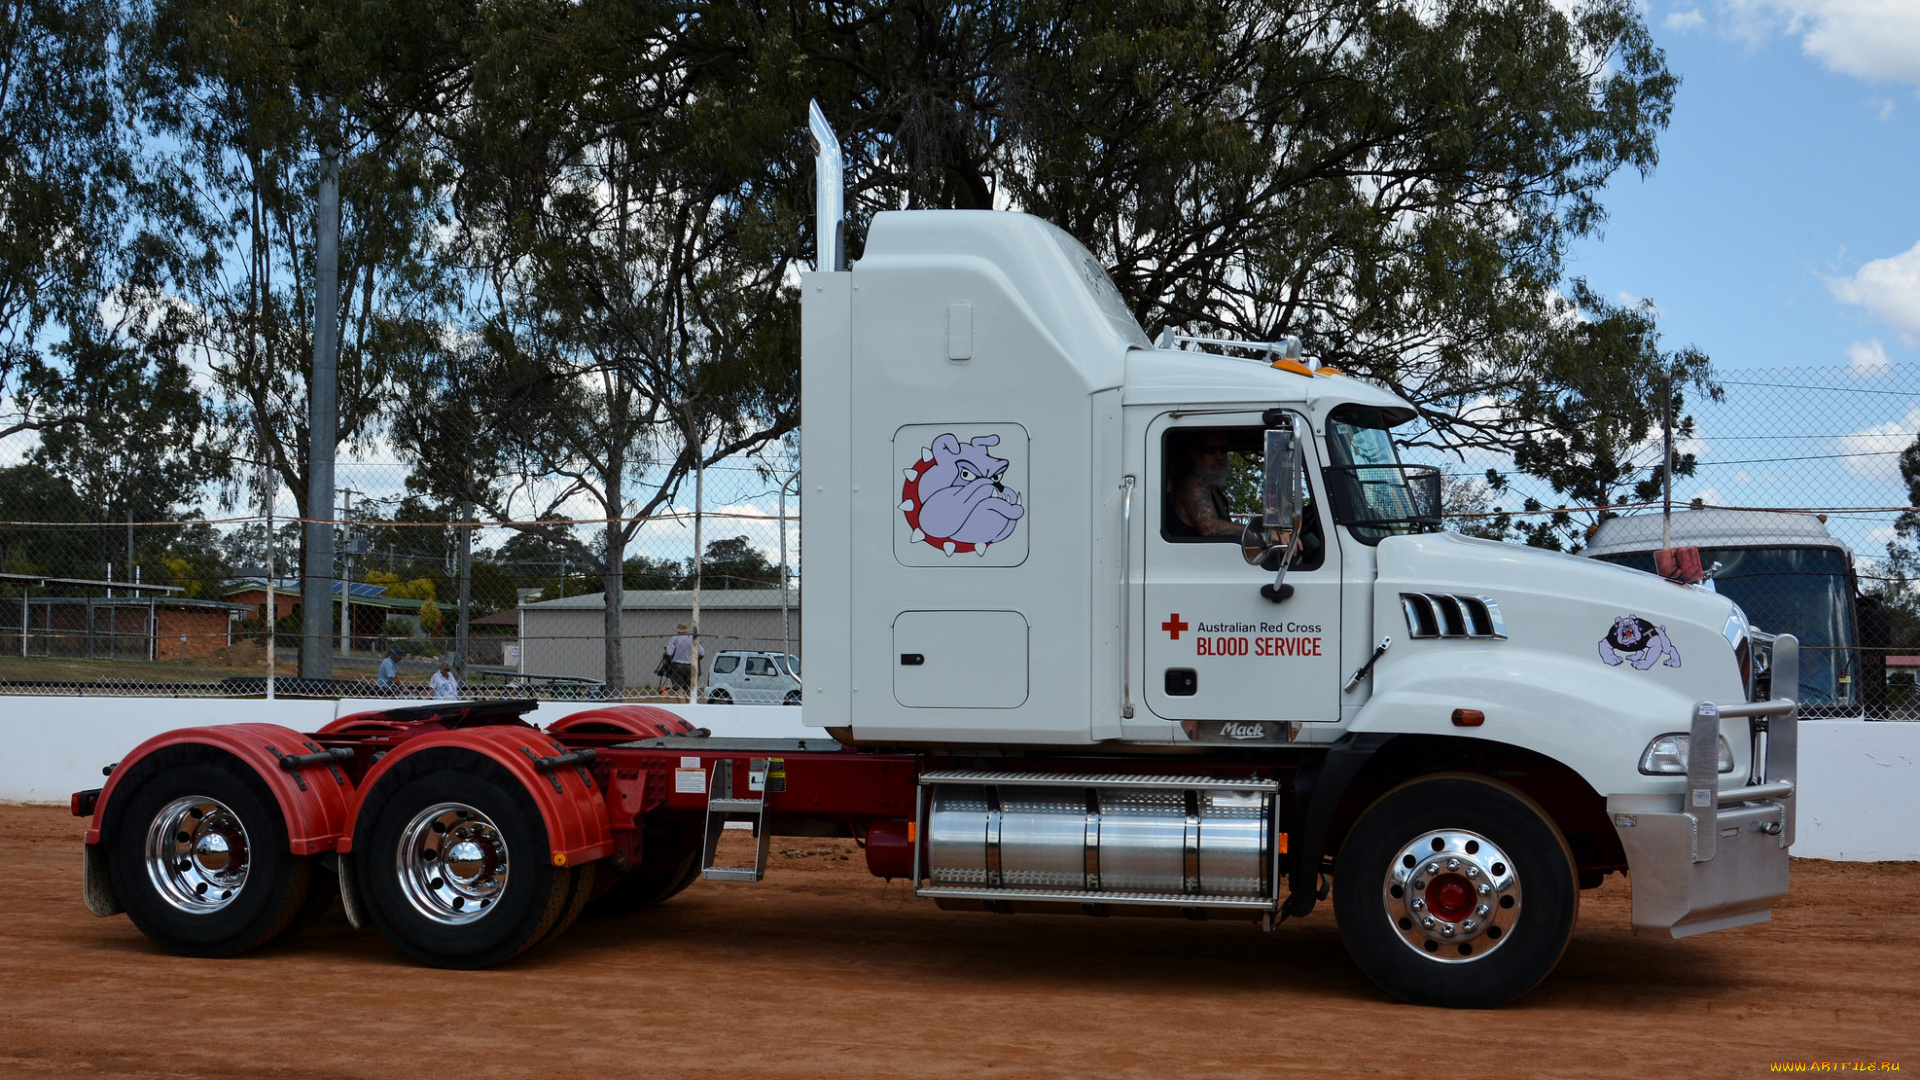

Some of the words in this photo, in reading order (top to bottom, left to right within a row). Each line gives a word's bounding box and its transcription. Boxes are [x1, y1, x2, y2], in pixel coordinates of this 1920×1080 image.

[1197, 622, 1256, 633] Australian
[1260, 622, 1283, 633] Red
[1286, 622, 1322, 633] Cross
[1196, 637, 1249, 656] BLOOD
[1255, 637, 1322, 656] SERVICE
[1219, 722, 1265, 738] Mack
